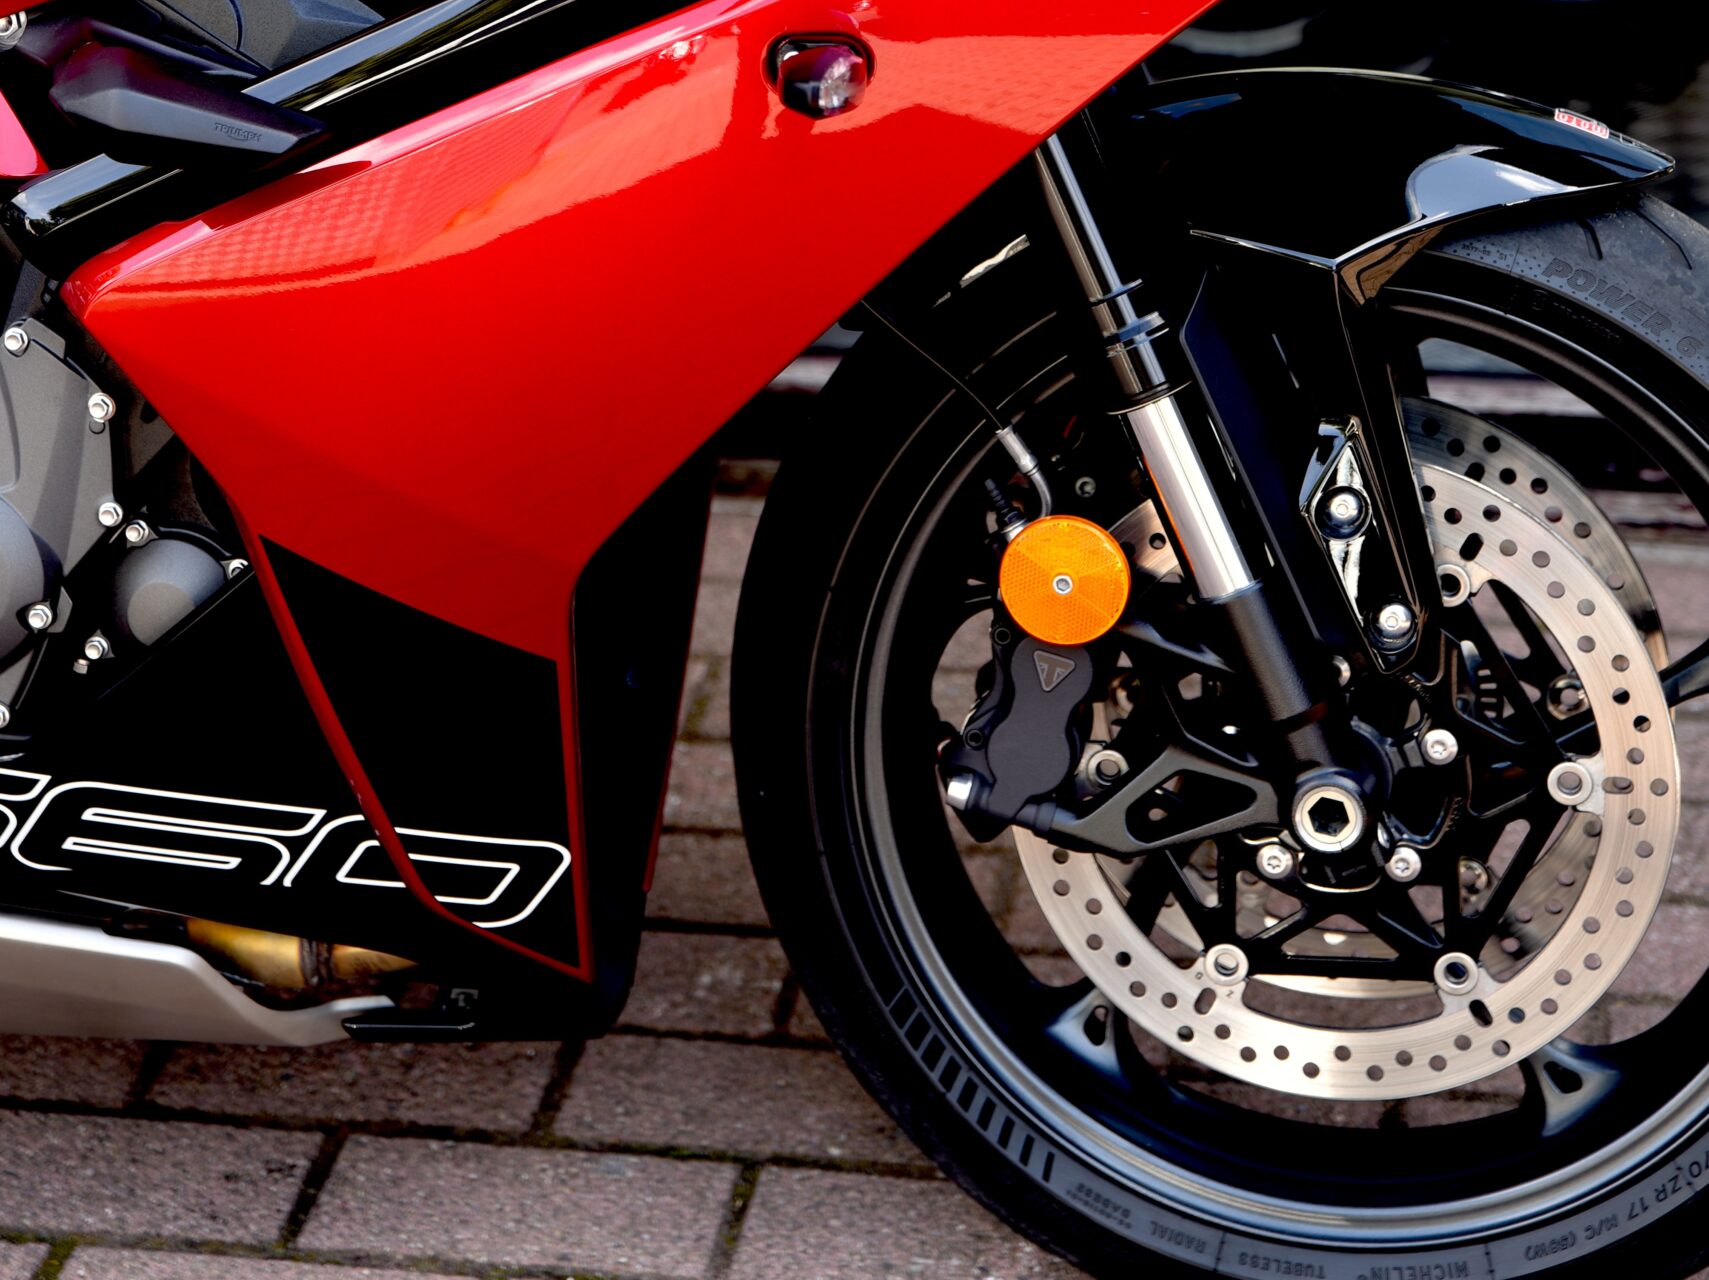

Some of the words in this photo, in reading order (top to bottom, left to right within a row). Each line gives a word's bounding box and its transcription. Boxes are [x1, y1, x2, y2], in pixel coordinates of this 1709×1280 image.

[1541, 257, 1672, 337] POWER
[0, 768, 573, 928] 60
[1654, 1174, 1683, 1203] ZR
[1627, 1196, 1649, 1221] 17
[1150, 1221, 1208, 1254] RADIAL
[1238, 1251, 1326, 1279] TUBELESS
